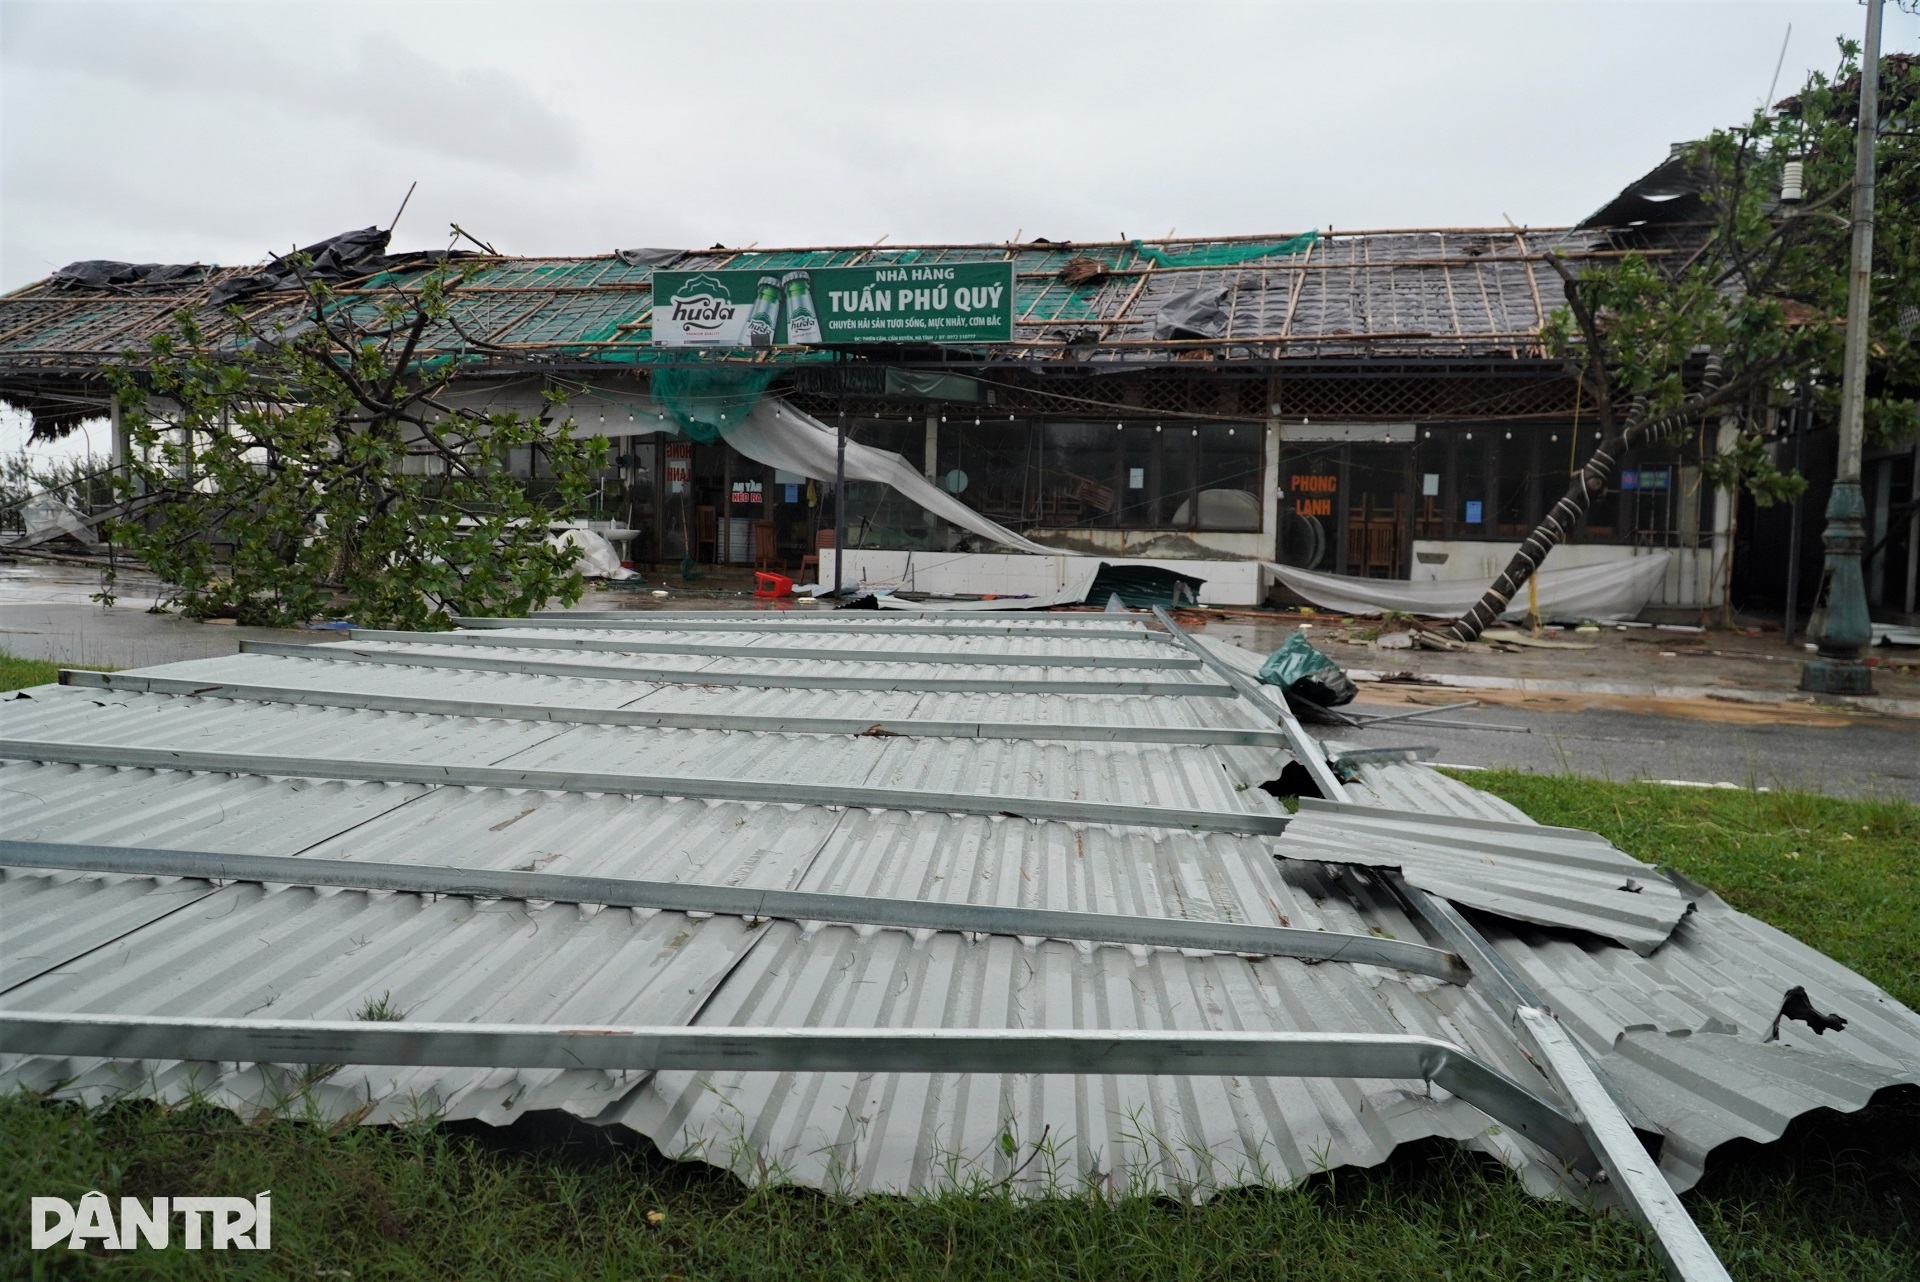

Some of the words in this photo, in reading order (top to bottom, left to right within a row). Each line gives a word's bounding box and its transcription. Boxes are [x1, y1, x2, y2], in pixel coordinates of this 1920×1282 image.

[876, 269, 908, 282] NHÀ
[912, 267, 955, 281] HÀNG
[828, 283, 892, 313] TUẤN
[898, 283, 948, 311] PHÚ
[954, 281, 1004, 312] QUÝ
[671, 297, 736, 321] huda
[790, 316, 815, 330] huda
[828, 318, 857, 330] CHUYÊN
[857, 317, 871, 329] HẢI
[871, 317, 886, 329] SẢN
[886, 318, 904, 329] TƯƠI
[927, 317, 945, 330] MỰC
[968, 316, 985, 327] CƠM
[750, 493, 763, 503] RA
